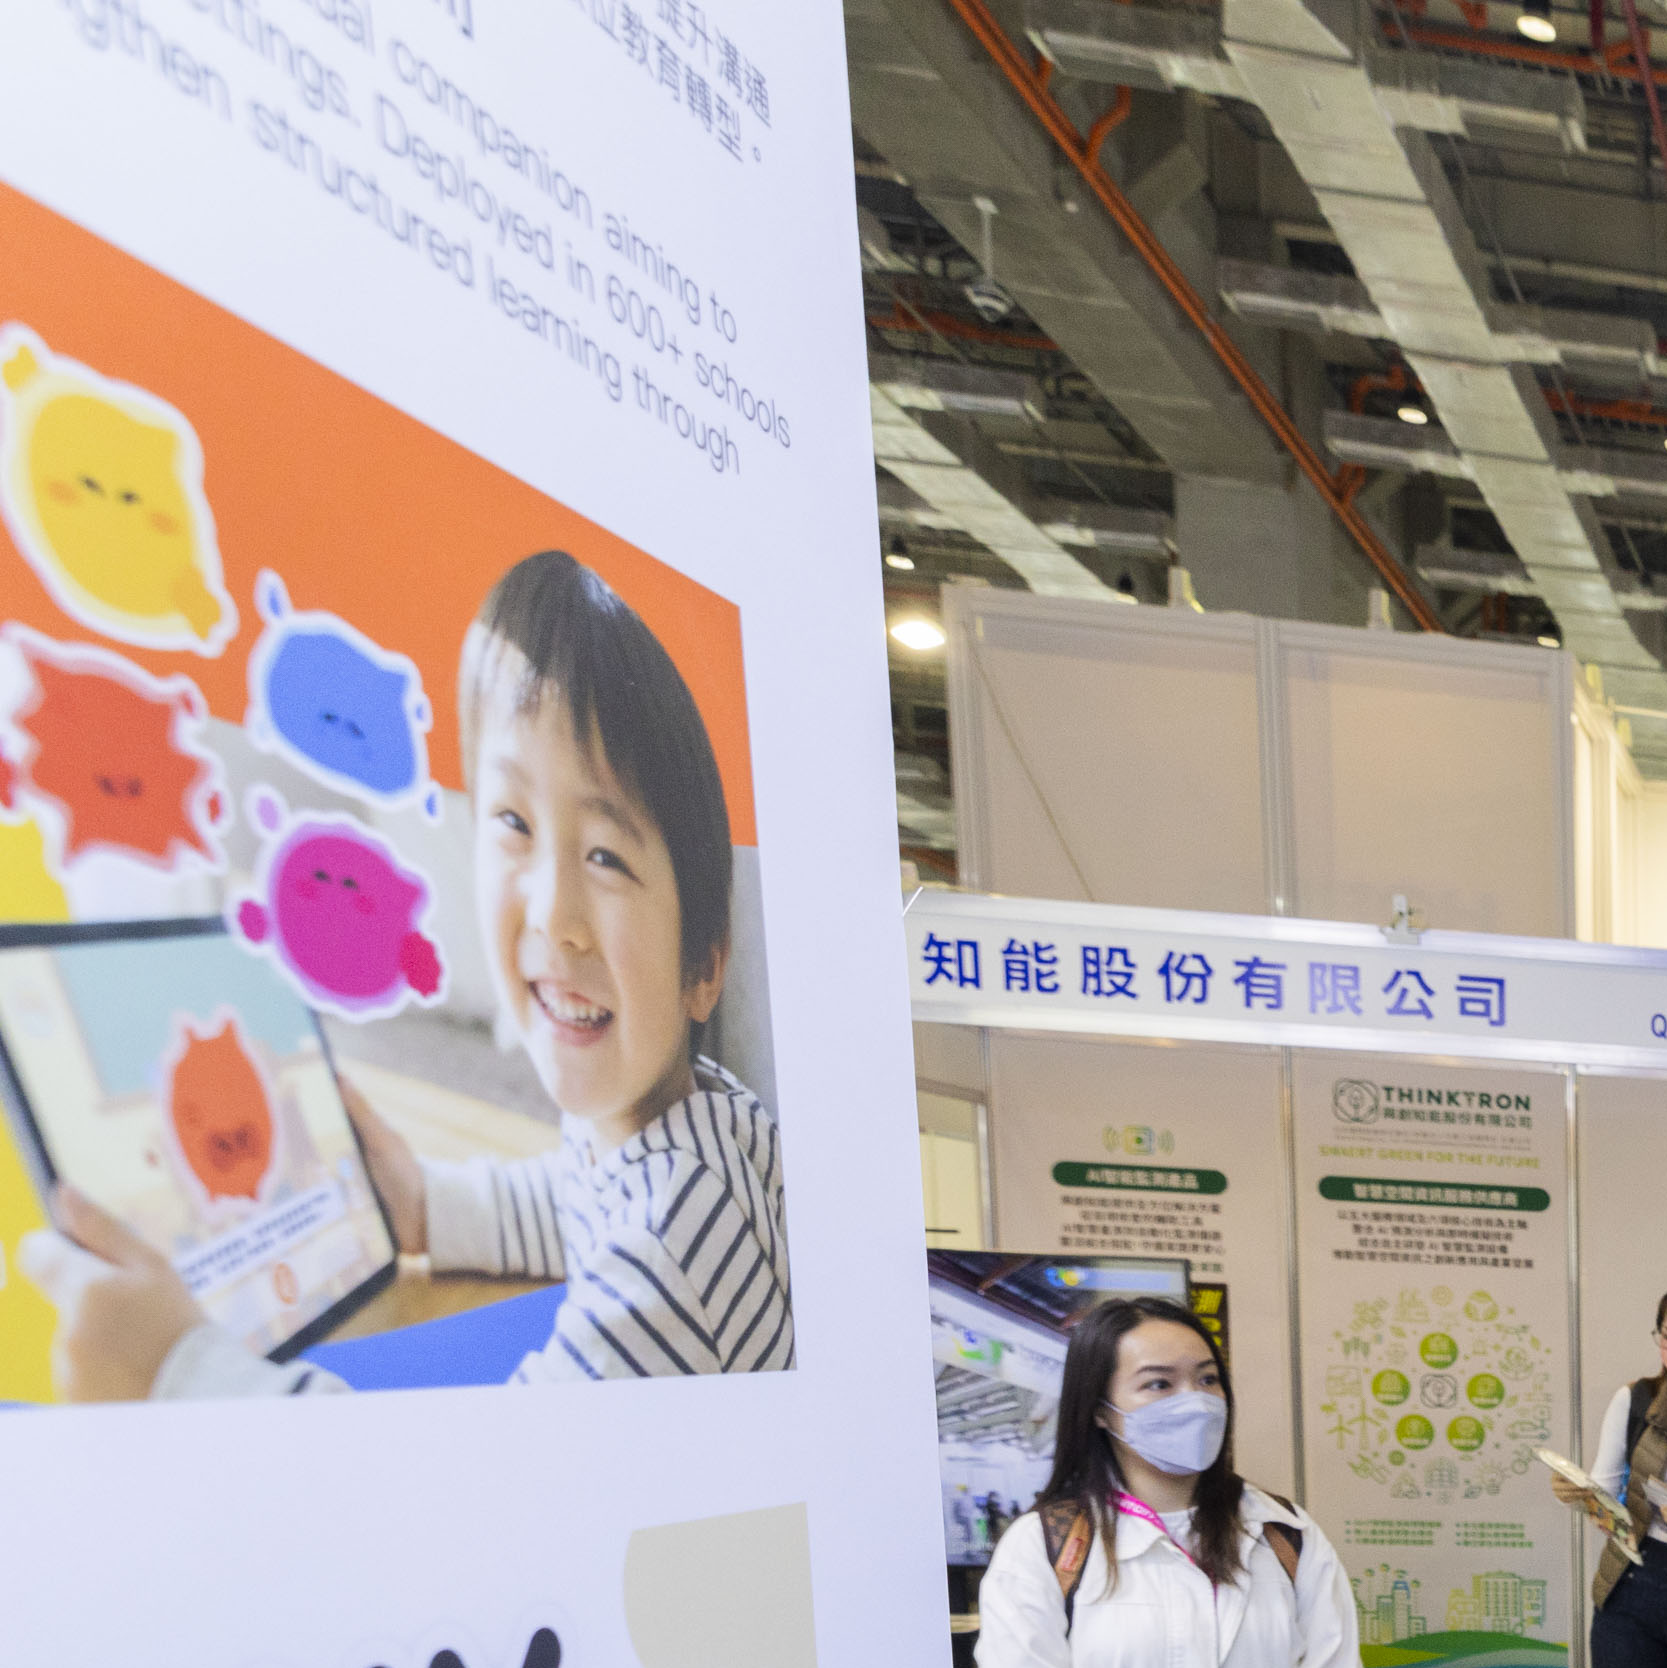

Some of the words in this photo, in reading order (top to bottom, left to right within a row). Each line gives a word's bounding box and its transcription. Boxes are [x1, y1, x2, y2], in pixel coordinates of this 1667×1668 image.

[250, 98, 475, 291] structured
[486, 252, 624, 404] learning
[632, 362, 741, 476] through
[375, 92, 556, 273] Deployed
[565, 240, 596, 305] in
[605, 272, 684, 366] 600+
[694, 350, 792, 449] schools
[389, 36, 594, 232] companion
[604, 210, 702, 327] aiming
[710, 290, 738, 345] to
[922, 932, 1508, 1027] 知能股份有限公司
